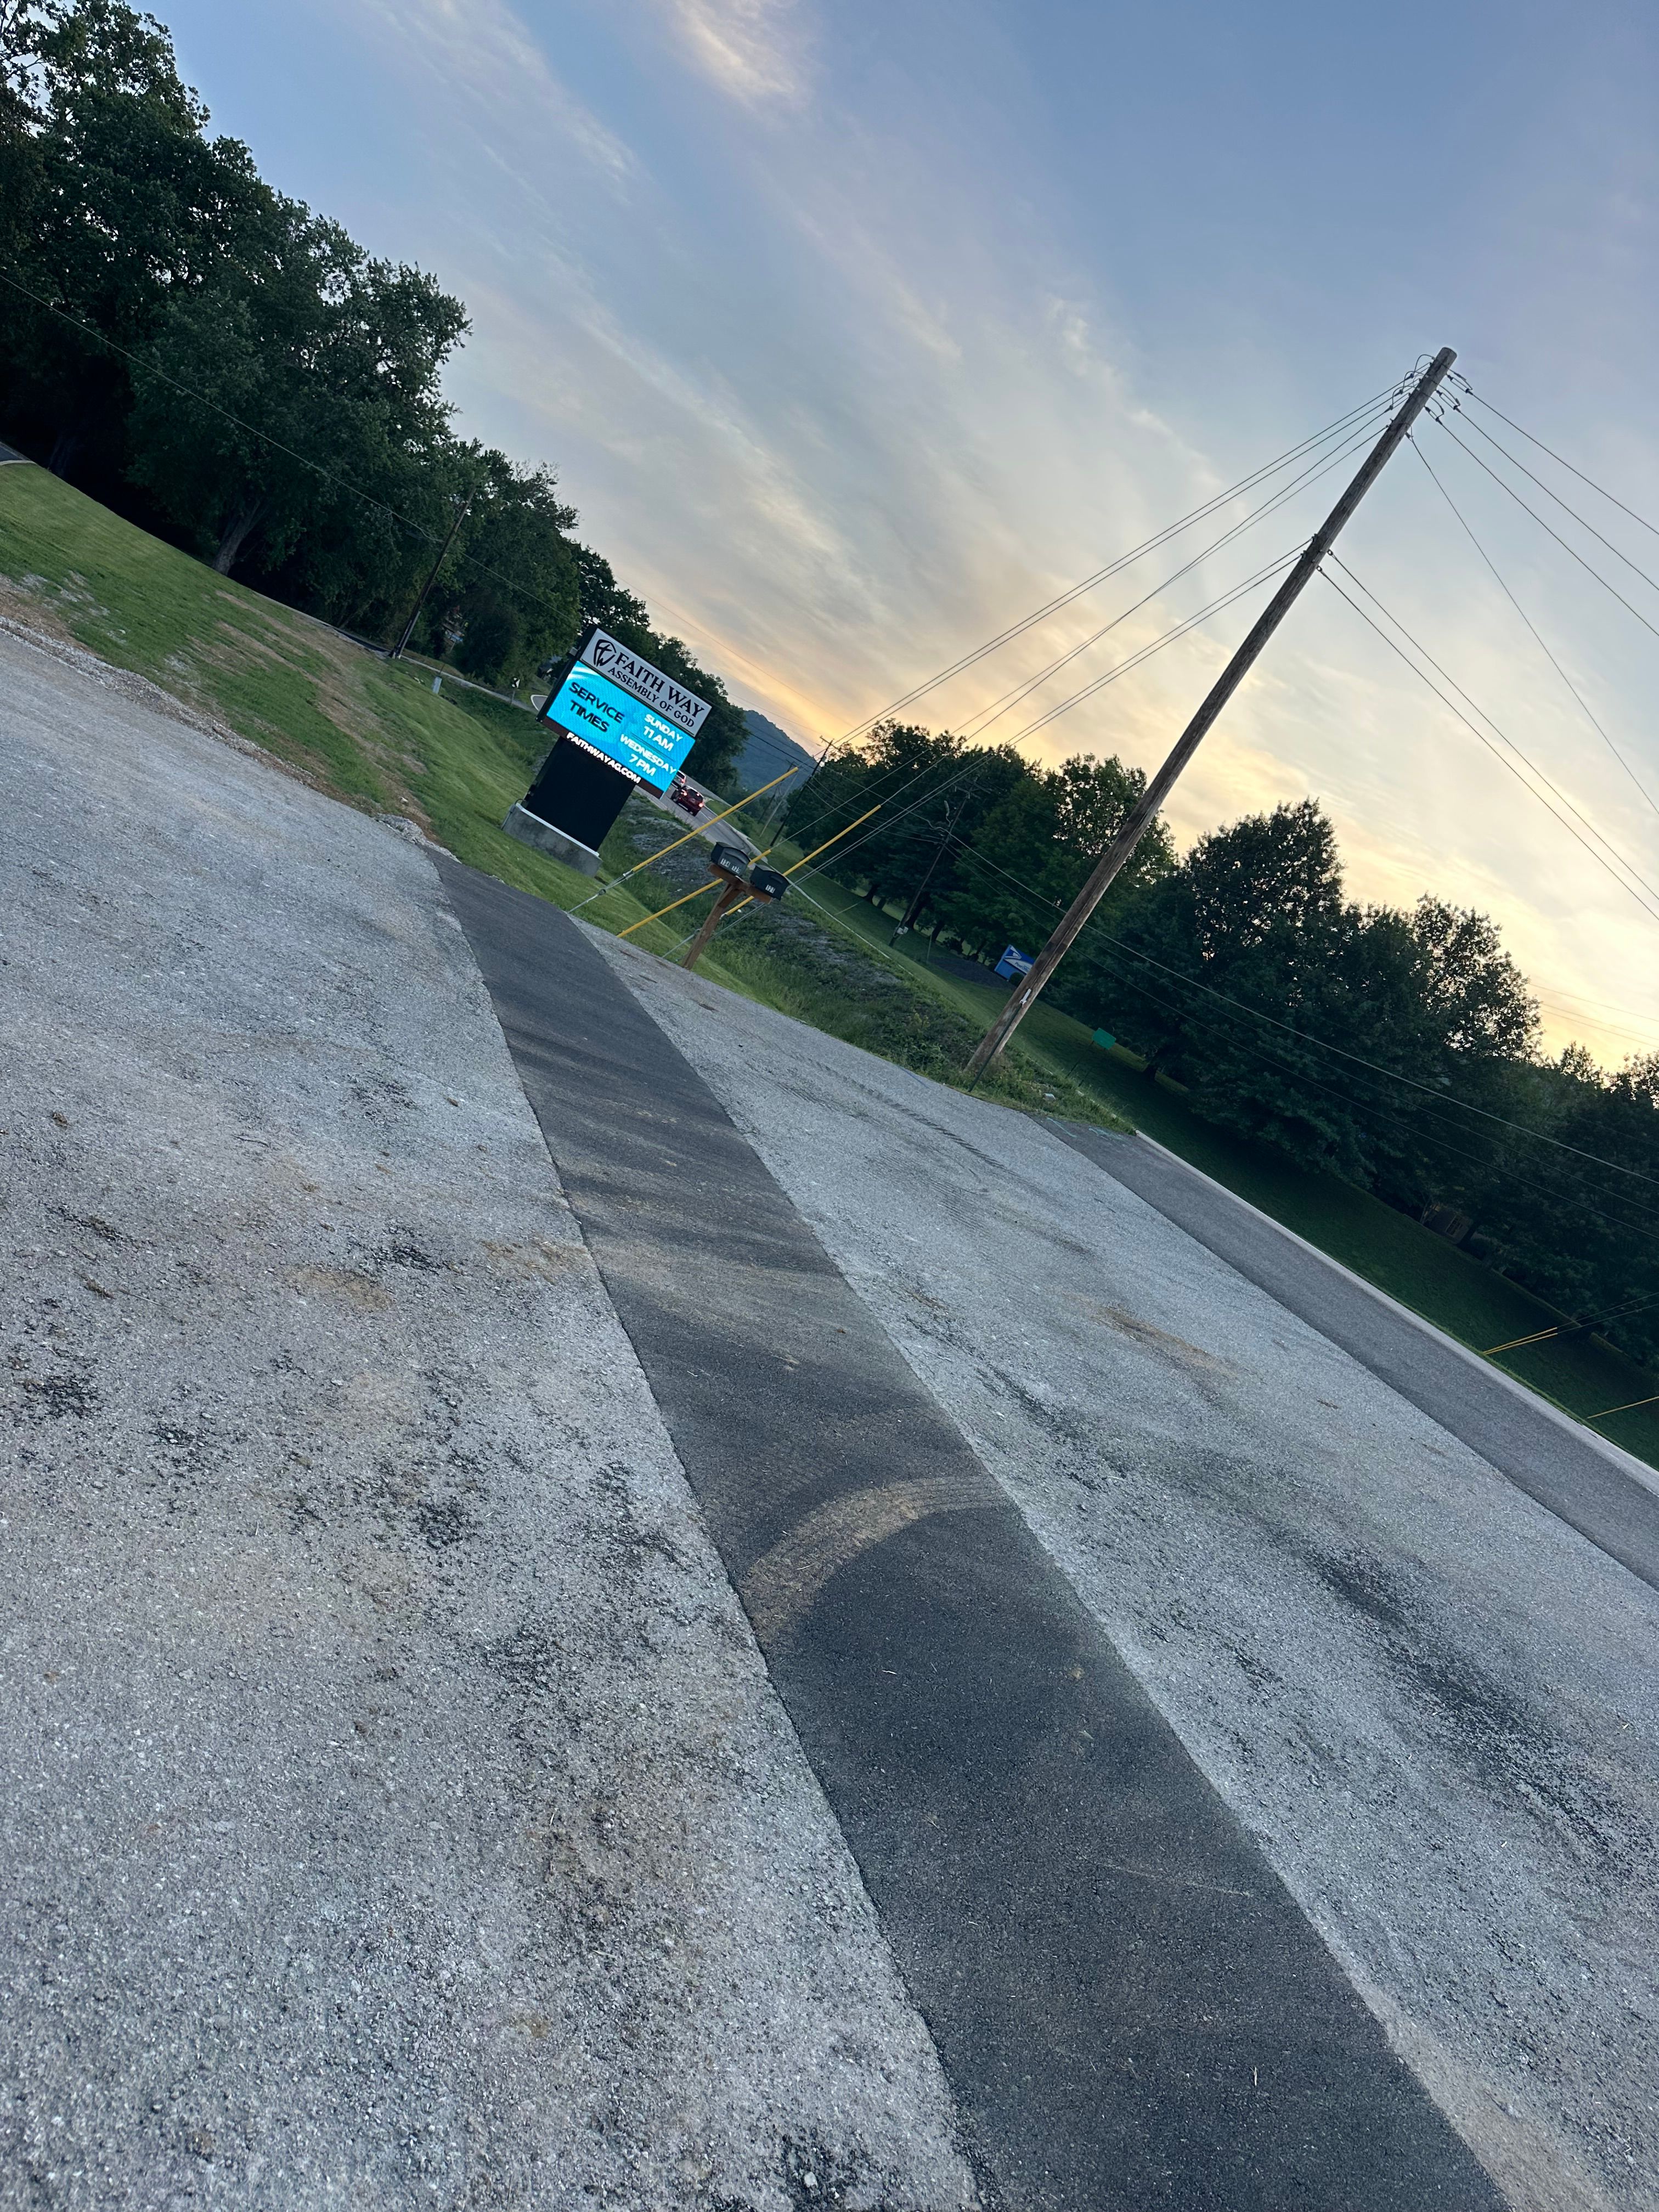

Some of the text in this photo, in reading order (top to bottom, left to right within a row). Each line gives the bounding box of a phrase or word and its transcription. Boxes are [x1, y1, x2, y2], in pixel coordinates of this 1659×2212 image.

[569, 682, 625, 724] SERVICE
[608, 667, 695, 727] ASSEMBLY OF GOD
[614, 652, 704, 718] FAITH WAY
[570, 699, 610, 732] TIMES
[645, 714, 683, 742] SUNDAY
[567, 732, 641, 783] FAITHWAYAG.COM
[620, 733, 676, 774] WEDNESDAY
[644, 726, 674, 751] 11 AM
[629, 754, 656, 776] 7 PM
